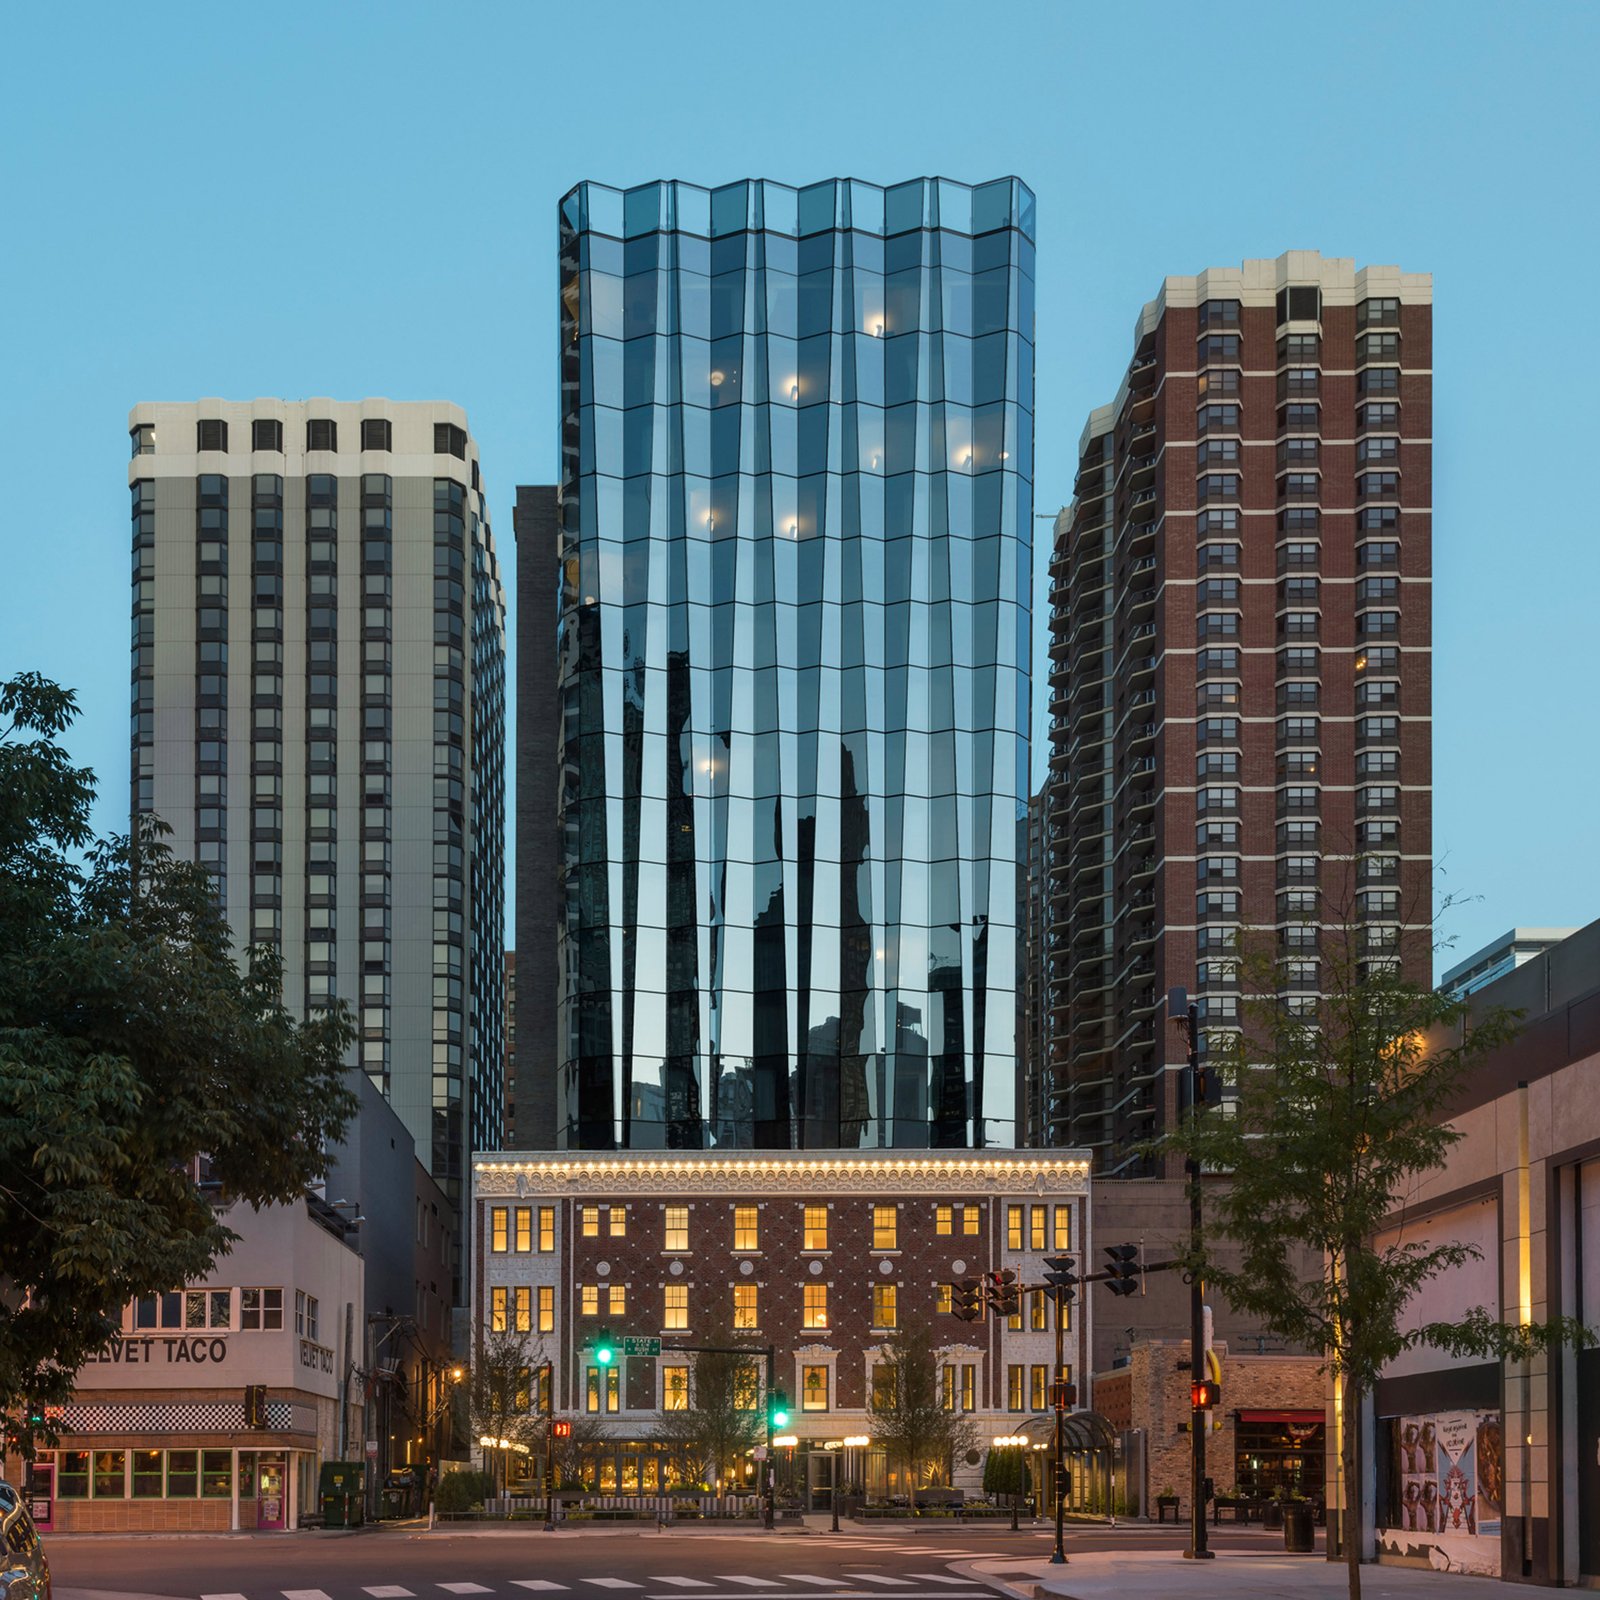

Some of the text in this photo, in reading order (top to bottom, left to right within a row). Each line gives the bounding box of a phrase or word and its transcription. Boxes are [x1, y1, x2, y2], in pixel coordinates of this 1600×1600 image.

[162, 1338, 227, 1363] TACO
[299, 1341, 334, 1375] VELVET TACO
